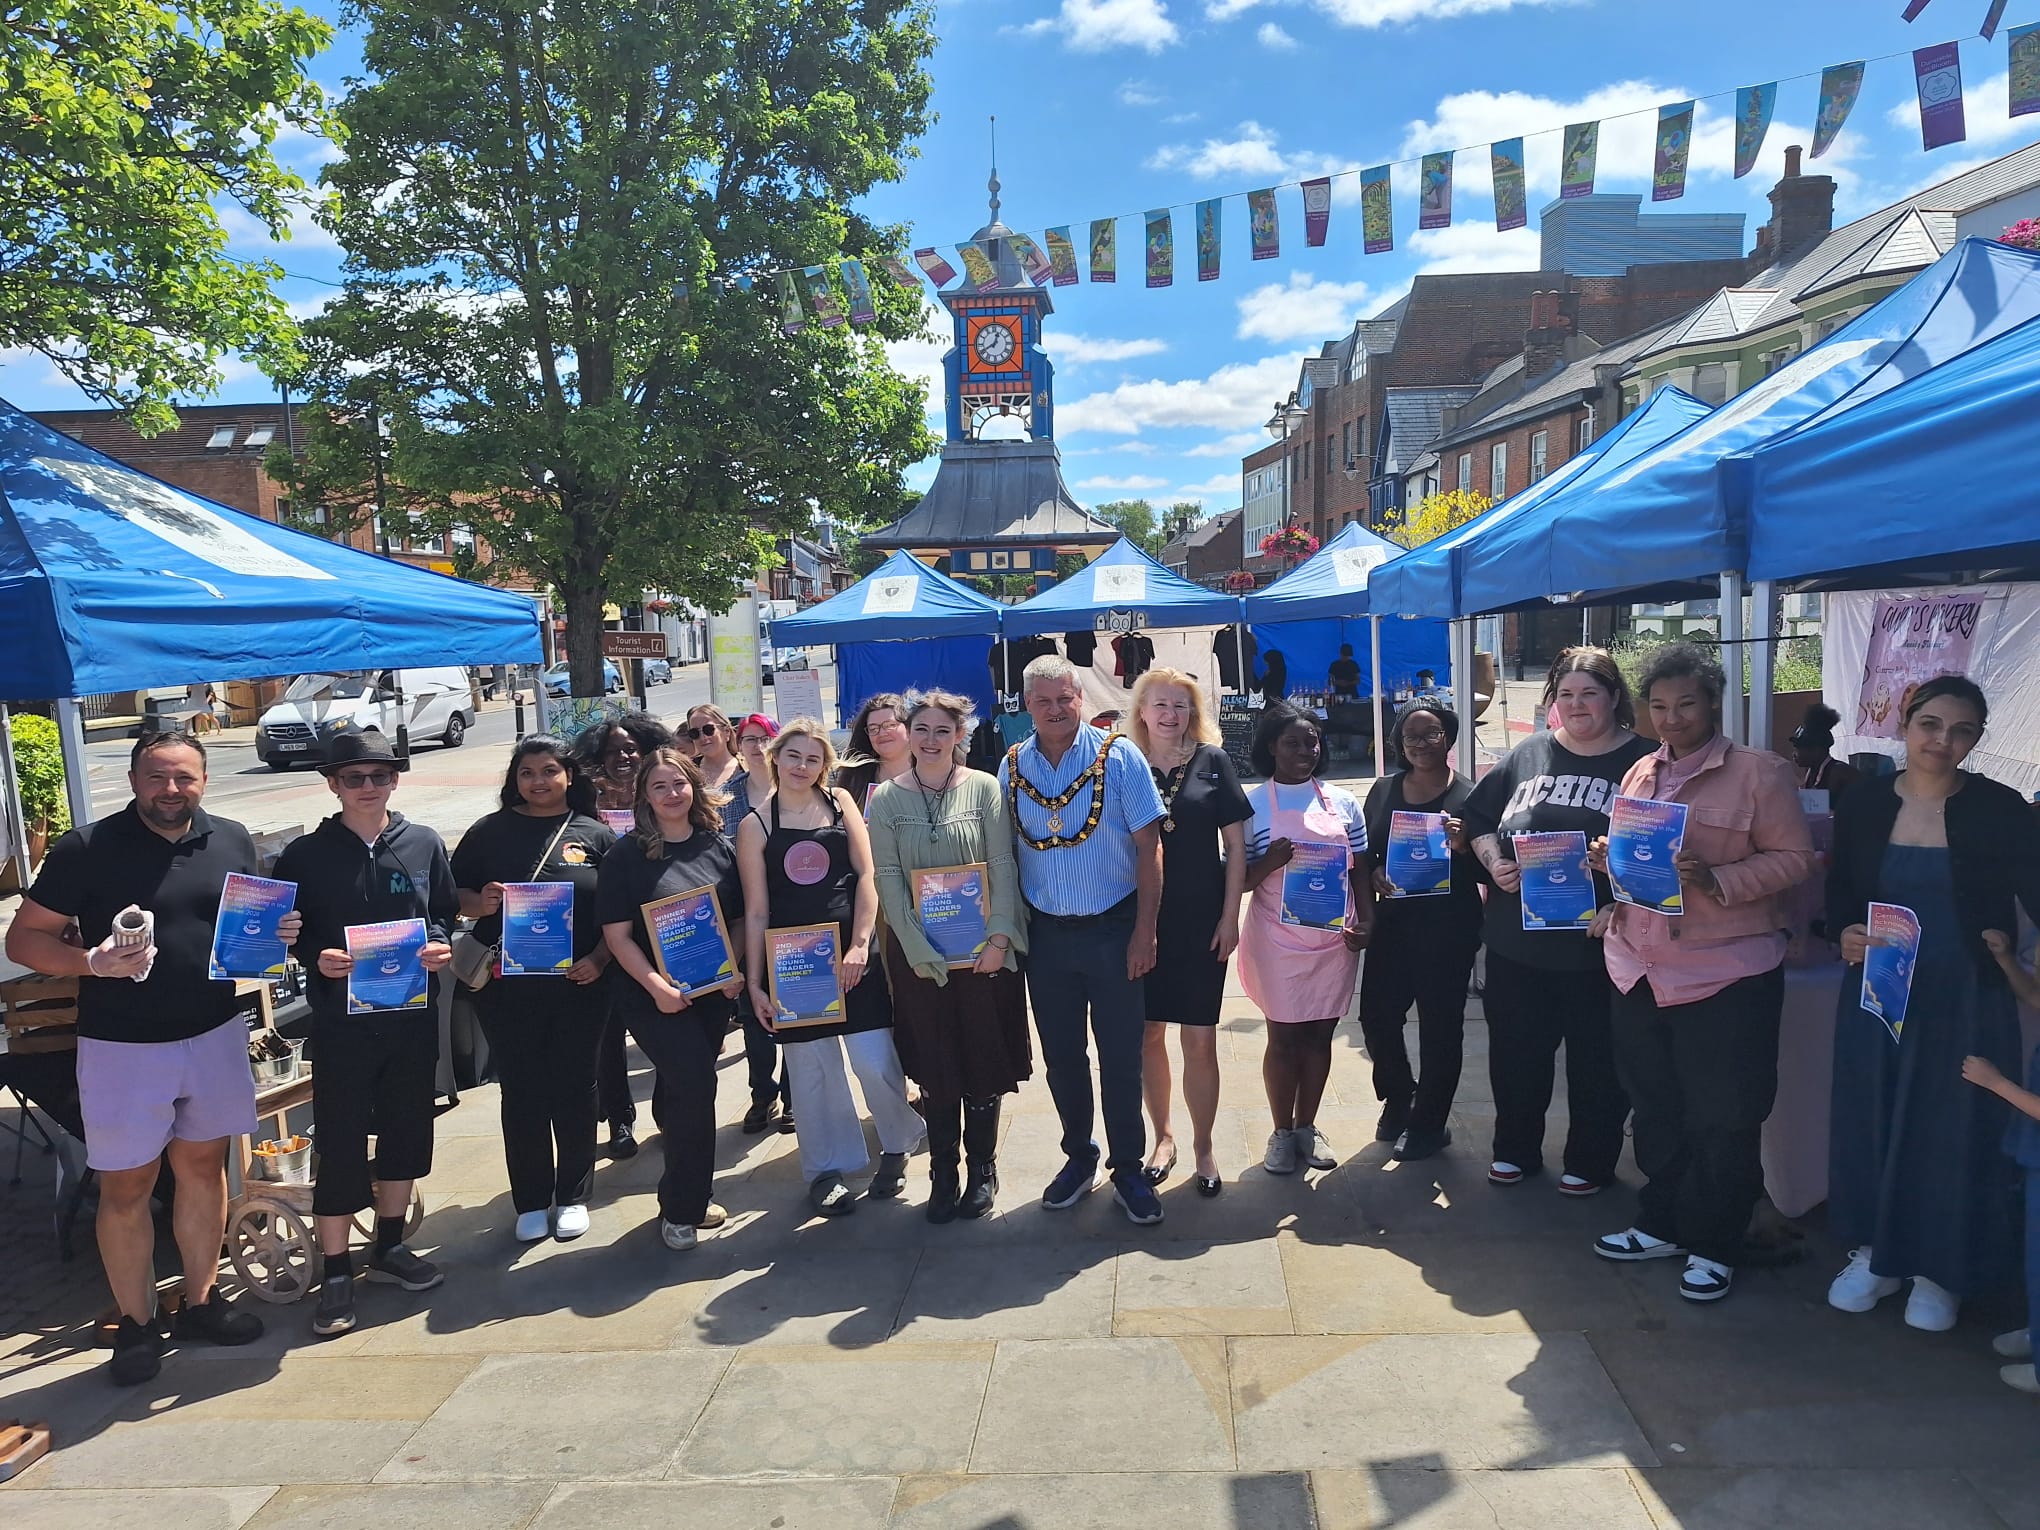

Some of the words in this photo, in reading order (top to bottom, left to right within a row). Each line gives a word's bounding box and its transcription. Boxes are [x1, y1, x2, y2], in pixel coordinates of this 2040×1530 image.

[616, 636, 641, 644] Tourist
[608, 646, 651, 654] Information
[1222, 695, 1248, 705] BLEACH
[1220, 712, 1251, 721] CLOTHING
[1498, 774, 1621, 831] MICHIGA
[1616, 805, 1642, 814] Certificate
[1622, 820, 1657, 830] participating
[923, 904, 961, 912] TRADERS
[655, 908, 686, 921] WINNER
[925, 910, 960, 918] MARKET
[656, 920, 668, 928] OF
[668, 915, 685, 925] THE
[657, 921, 686, 933] YOUNG
[659, 924, 696, 939] TRADERS
[662, 930, 696, 944] MARKET
[778, 964, 814, 972] TRADERS
